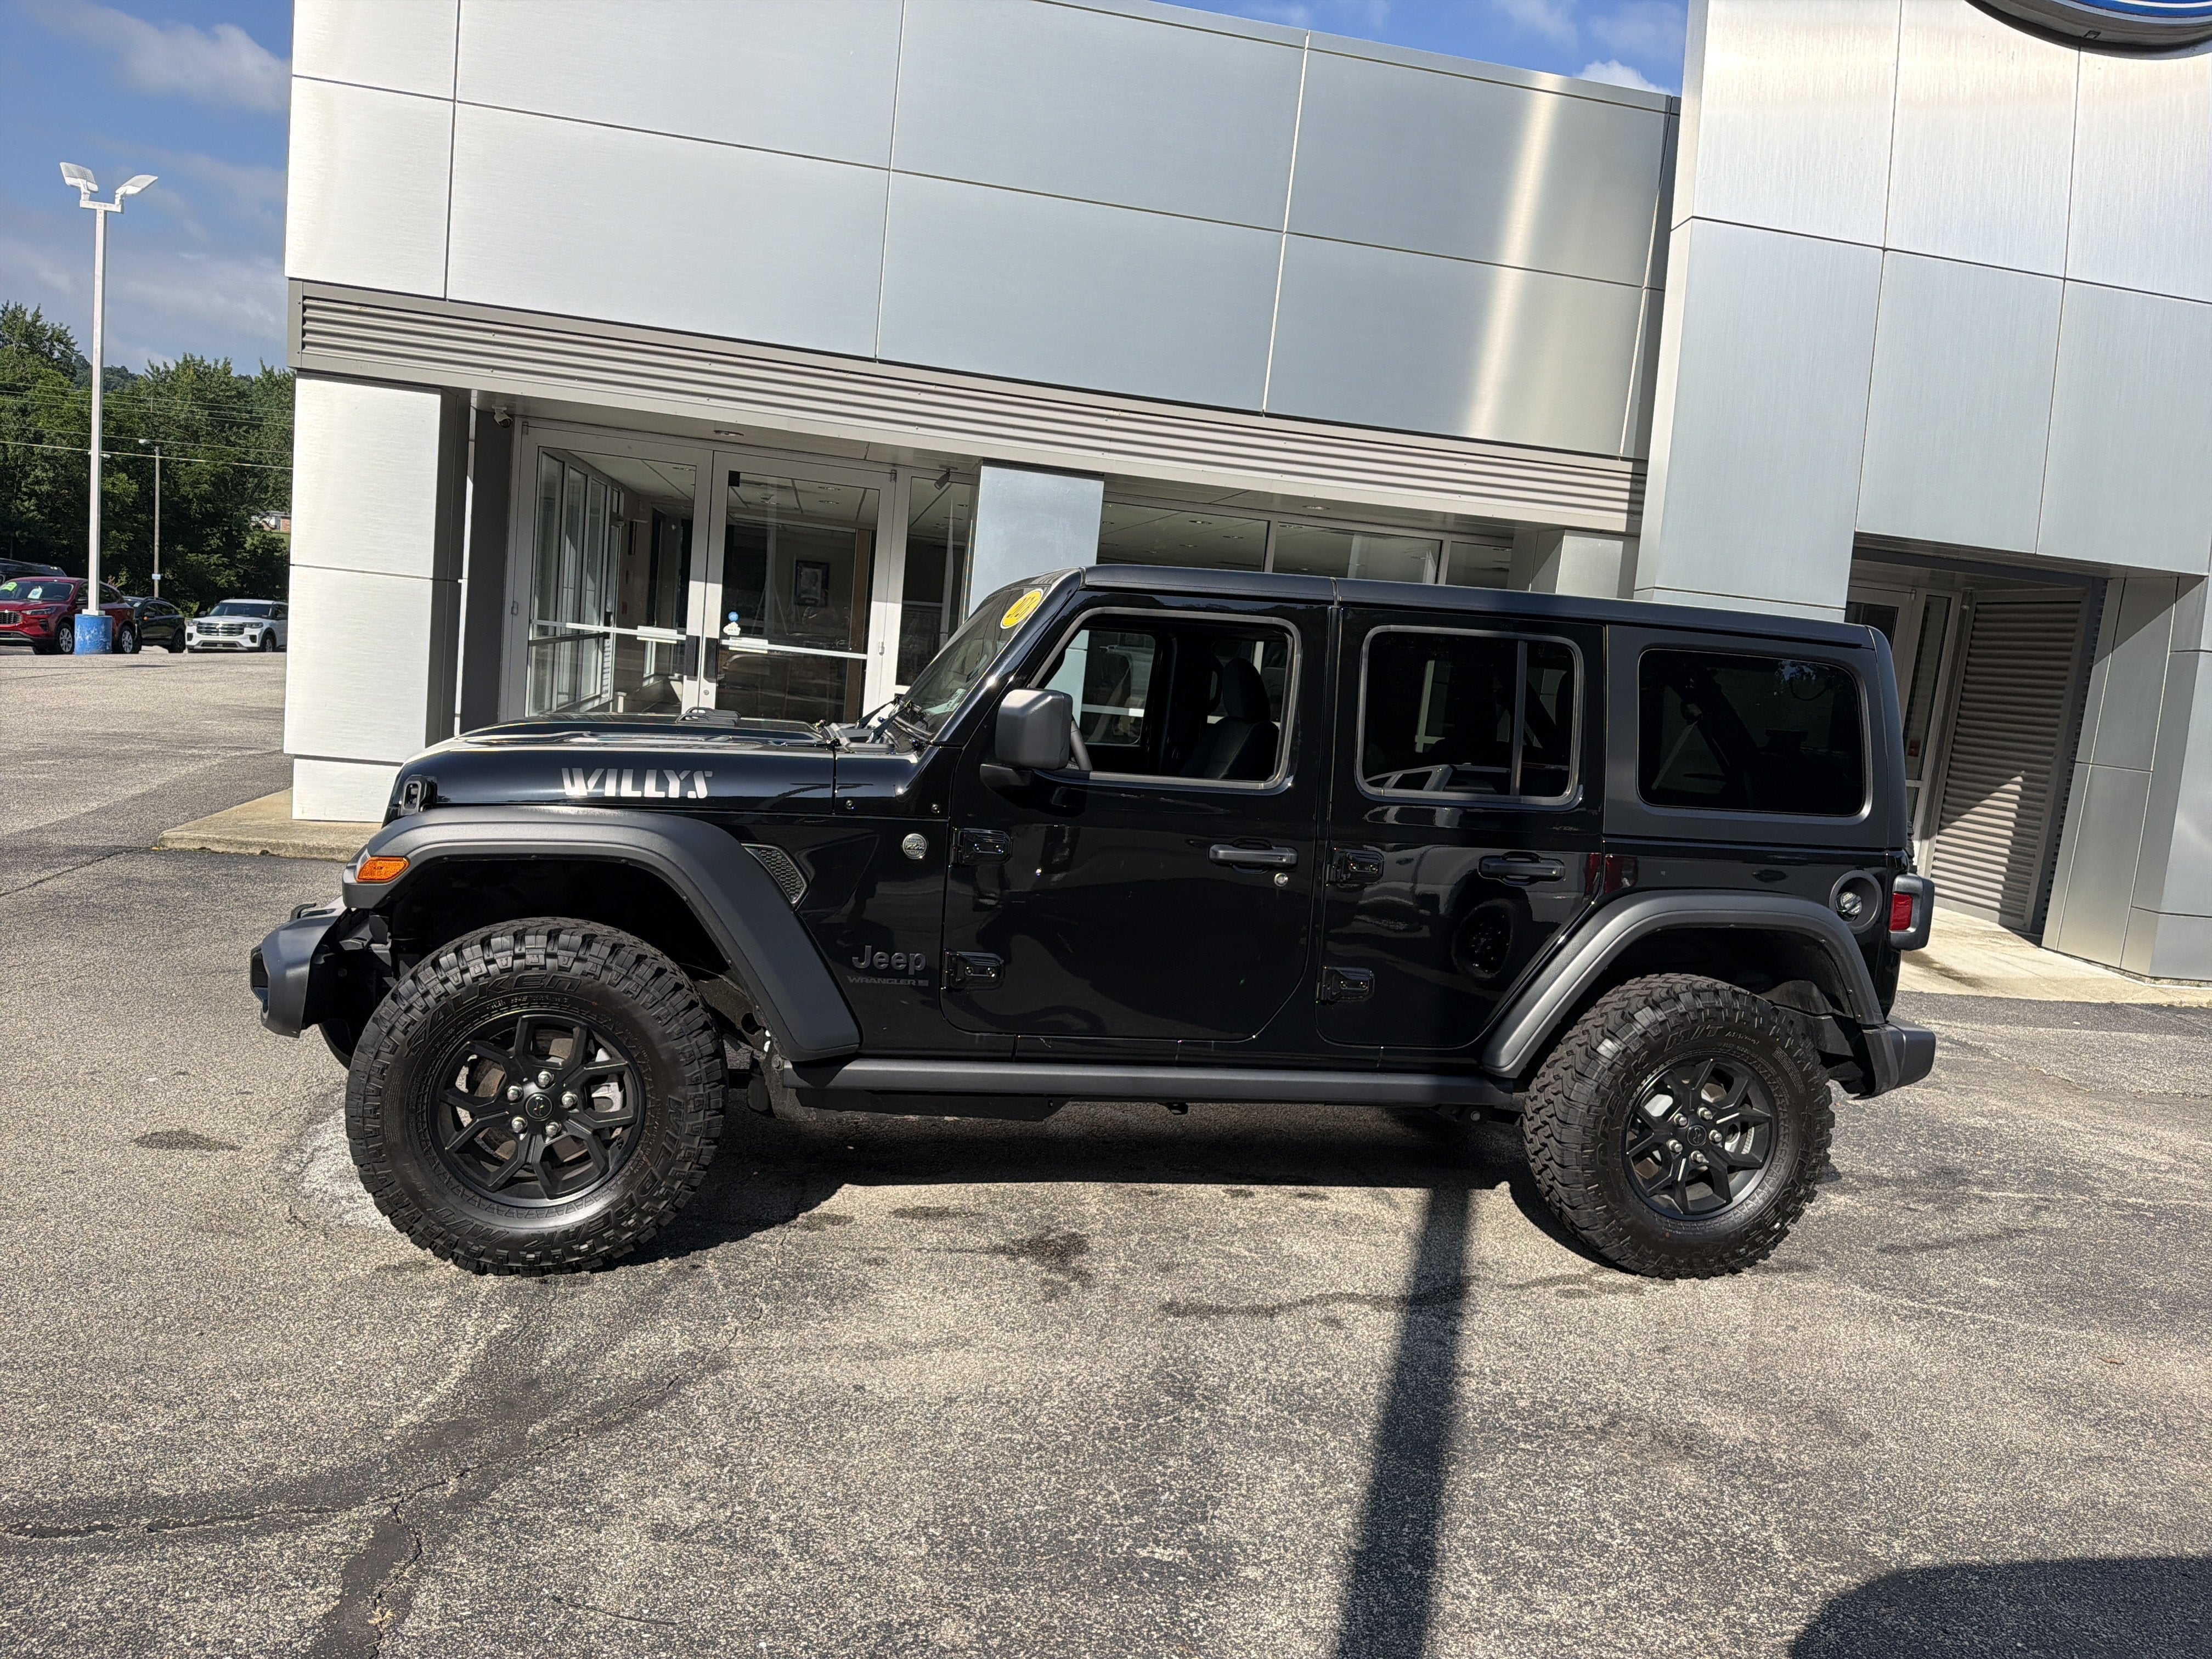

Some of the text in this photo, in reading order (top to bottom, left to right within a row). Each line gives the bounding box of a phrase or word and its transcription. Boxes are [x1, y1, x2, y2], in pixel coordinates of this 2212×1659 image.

[561, 768, 713, 799] WILLYS
[852, 945, 926, 975] Jeep
[847, 975, 916, 986] WRANGLER
[404, 972, 582, 1058] FALKEN
[523, 1095, 685, 1249] WILDPEAK
